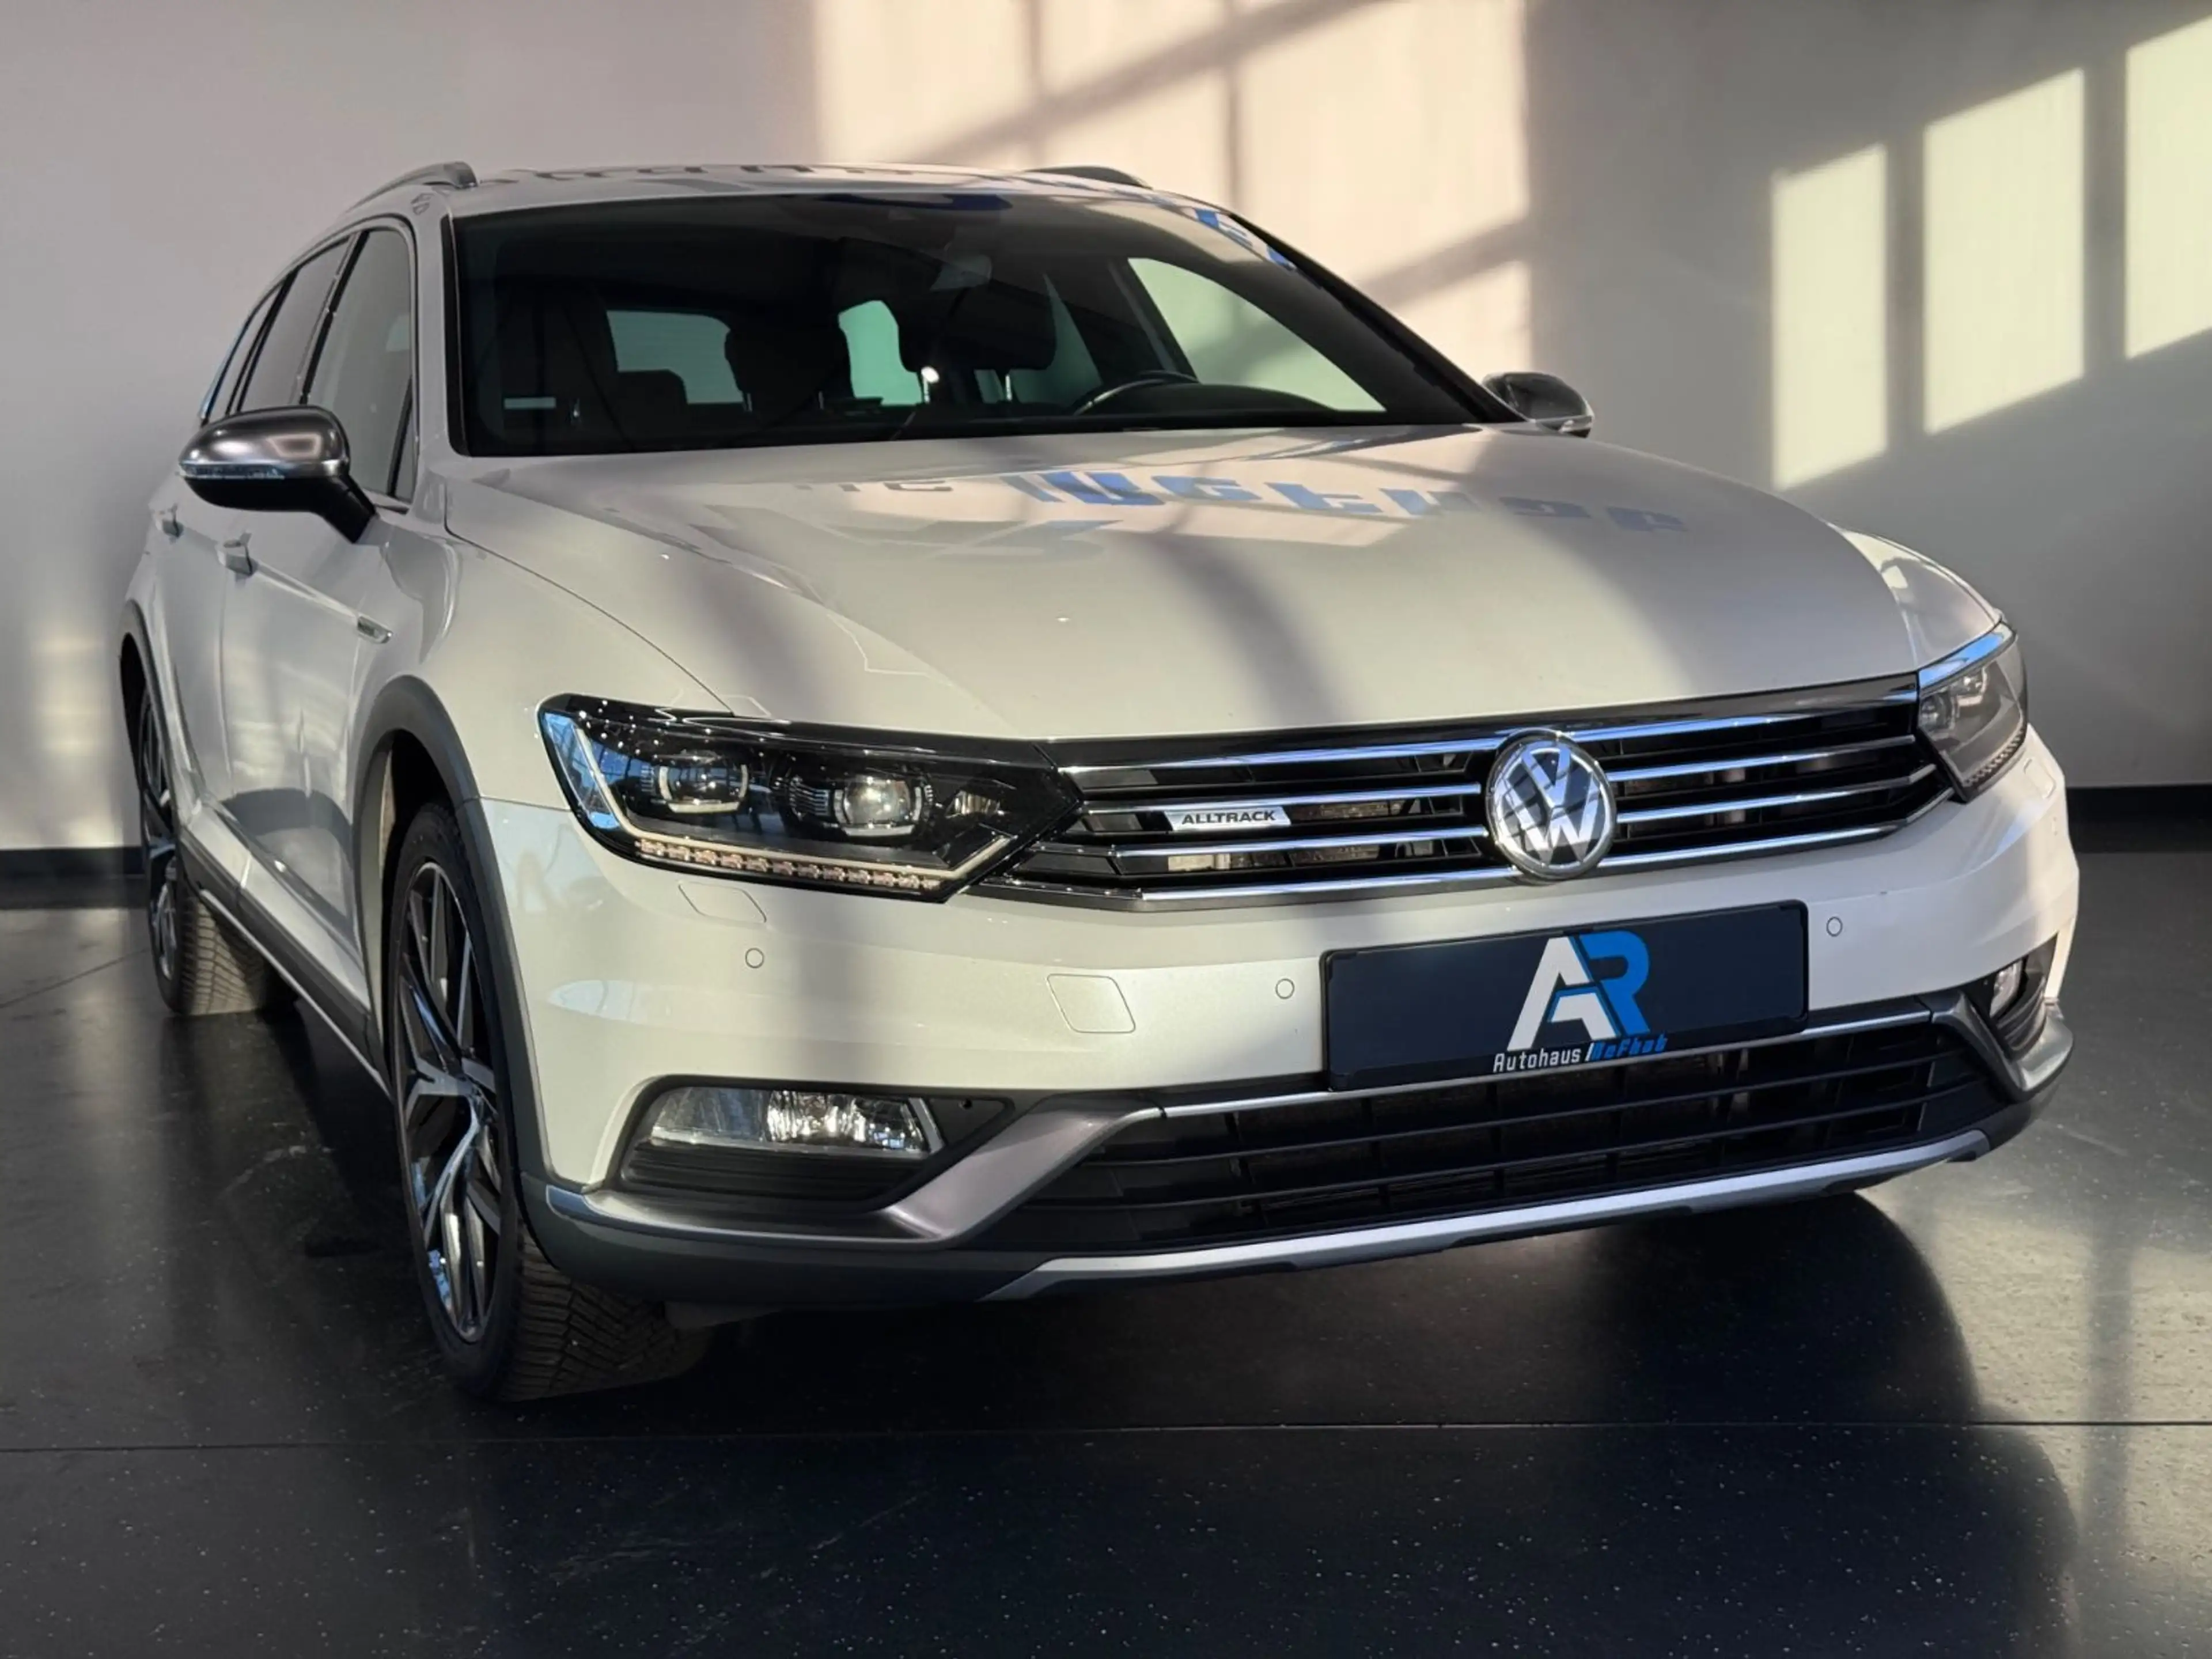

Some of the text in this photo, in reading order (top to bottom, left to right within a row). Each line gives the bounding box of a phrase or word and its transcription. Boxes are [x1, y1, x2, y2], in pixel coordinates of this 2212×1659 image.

[1182, 810, 1275, 825] ALLTRACK
[1507, 931, 1649, 1051] AR
[1493, 1048, 1582, 1073] Autohaus
